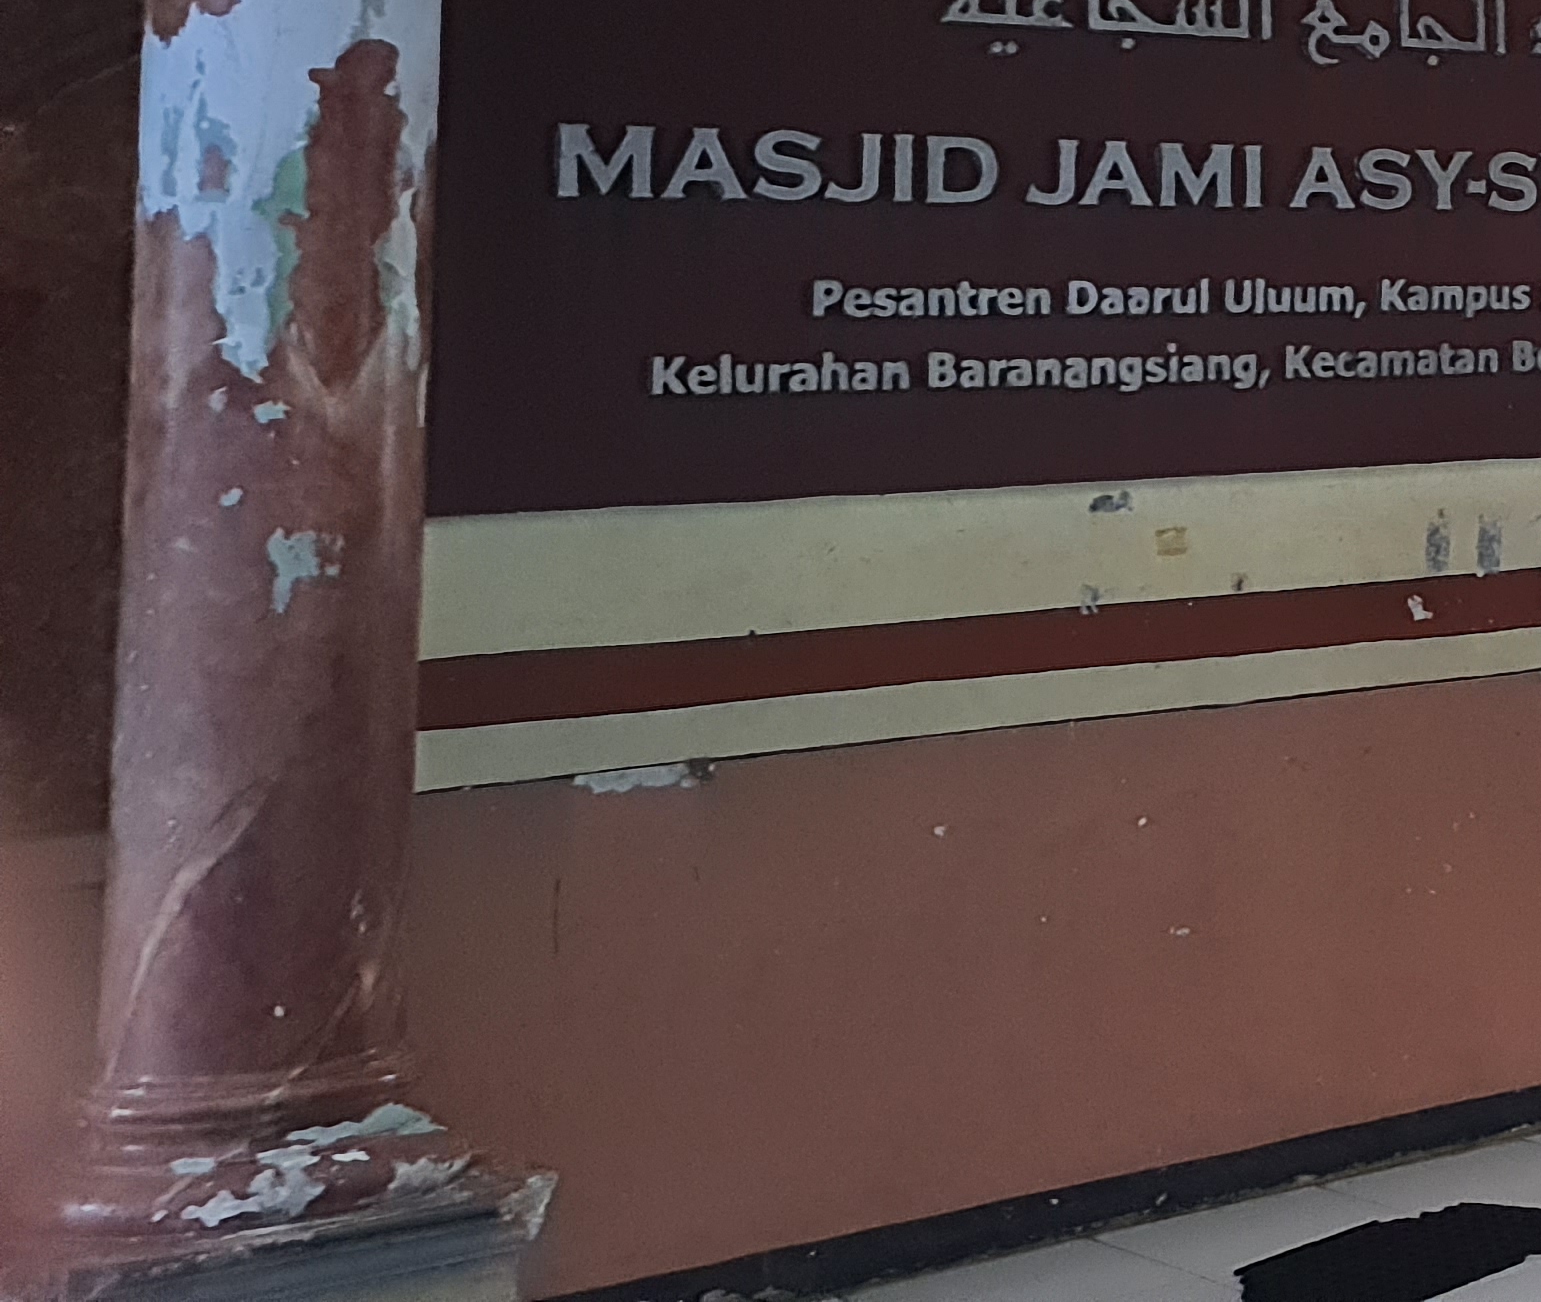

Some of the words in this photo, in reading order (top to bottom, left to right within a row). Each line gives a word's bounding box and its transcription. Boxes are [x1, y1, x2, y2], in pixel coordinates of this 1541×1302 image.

[555, 124, 1000, 204] MASJID
[1025, 139, 1263, 209] JAMI
[812, 279, 1052, 318] Pesantren
[1065, 277, 1210, 316] Daarul
[1223, 277, 1366, 319] Uluum,
[1379, 277, 1532, 319] Kampus
[651, 350, 911, 396] Kelurahan
[927, 341, 1271, 393] Baranangsiang,
[1284, 342, 1500, 380] Kecamatan
